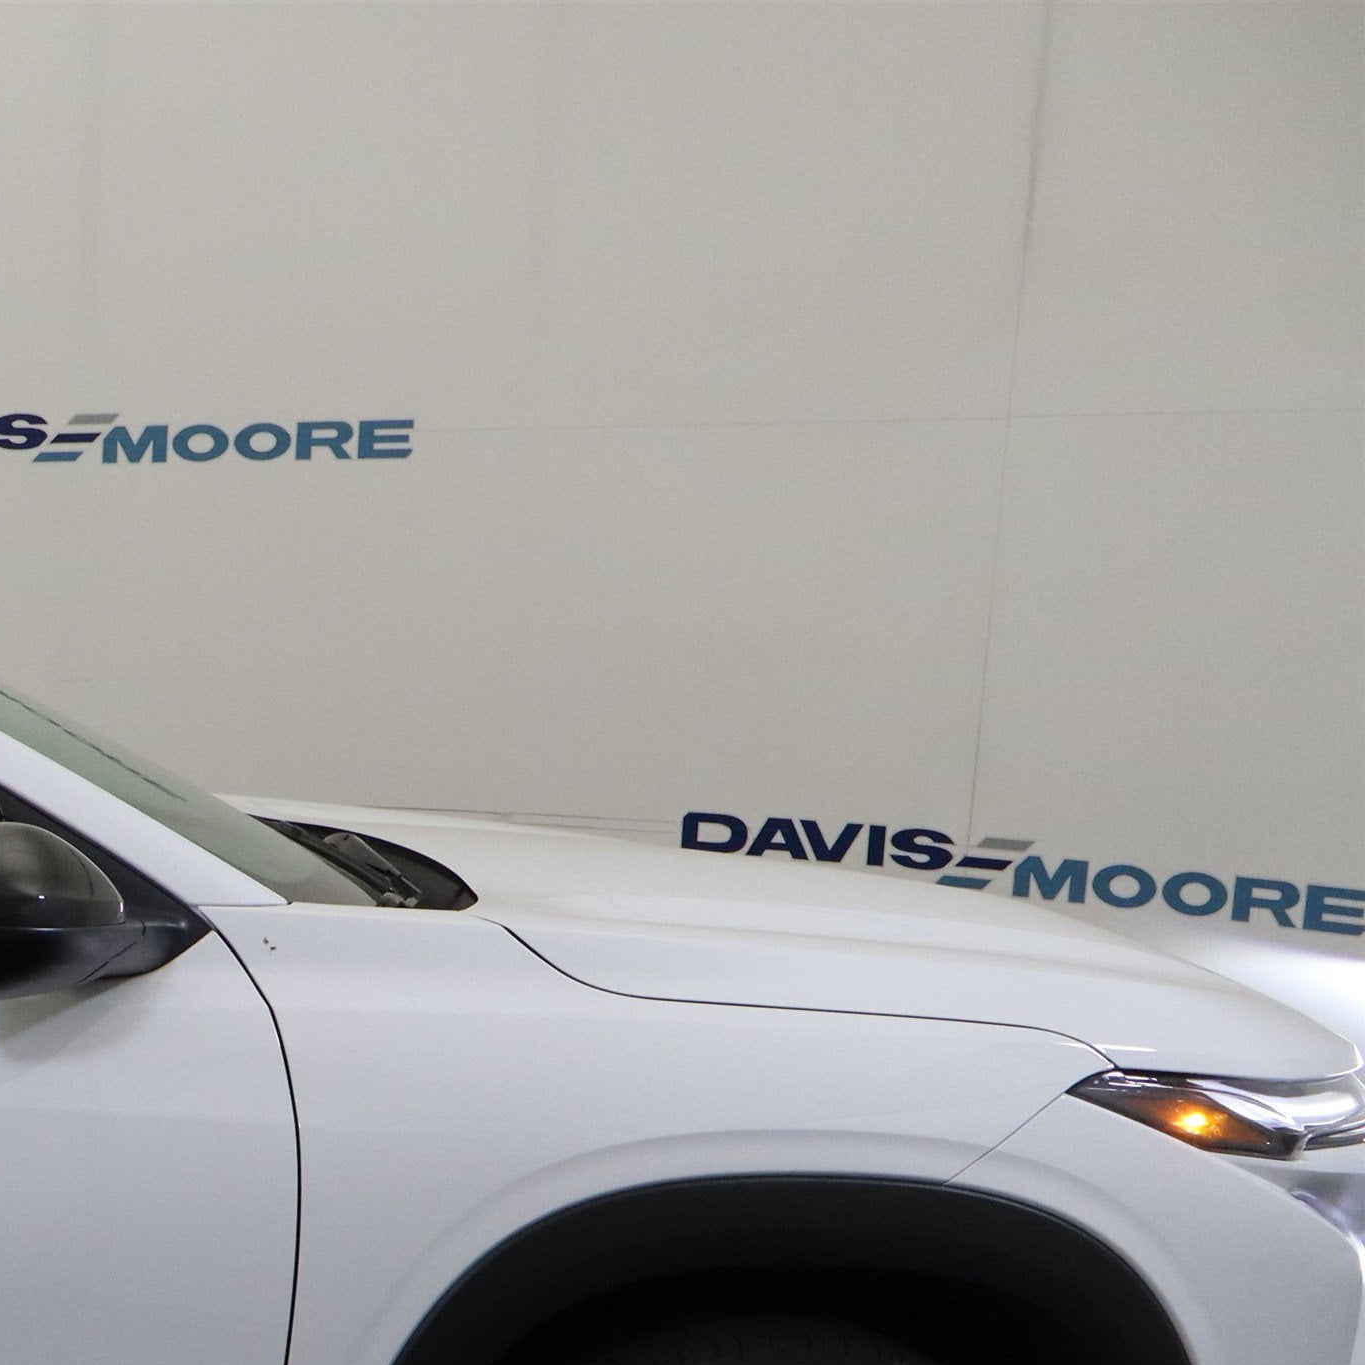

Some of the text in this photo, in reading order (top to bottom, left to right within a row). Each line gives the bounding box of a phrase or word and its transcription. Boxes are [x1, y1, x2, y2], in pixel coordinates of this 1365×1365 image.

[102, 419, 415, 463] MOORE
[680, 811, 1365, 936] DAVIS MOORE
